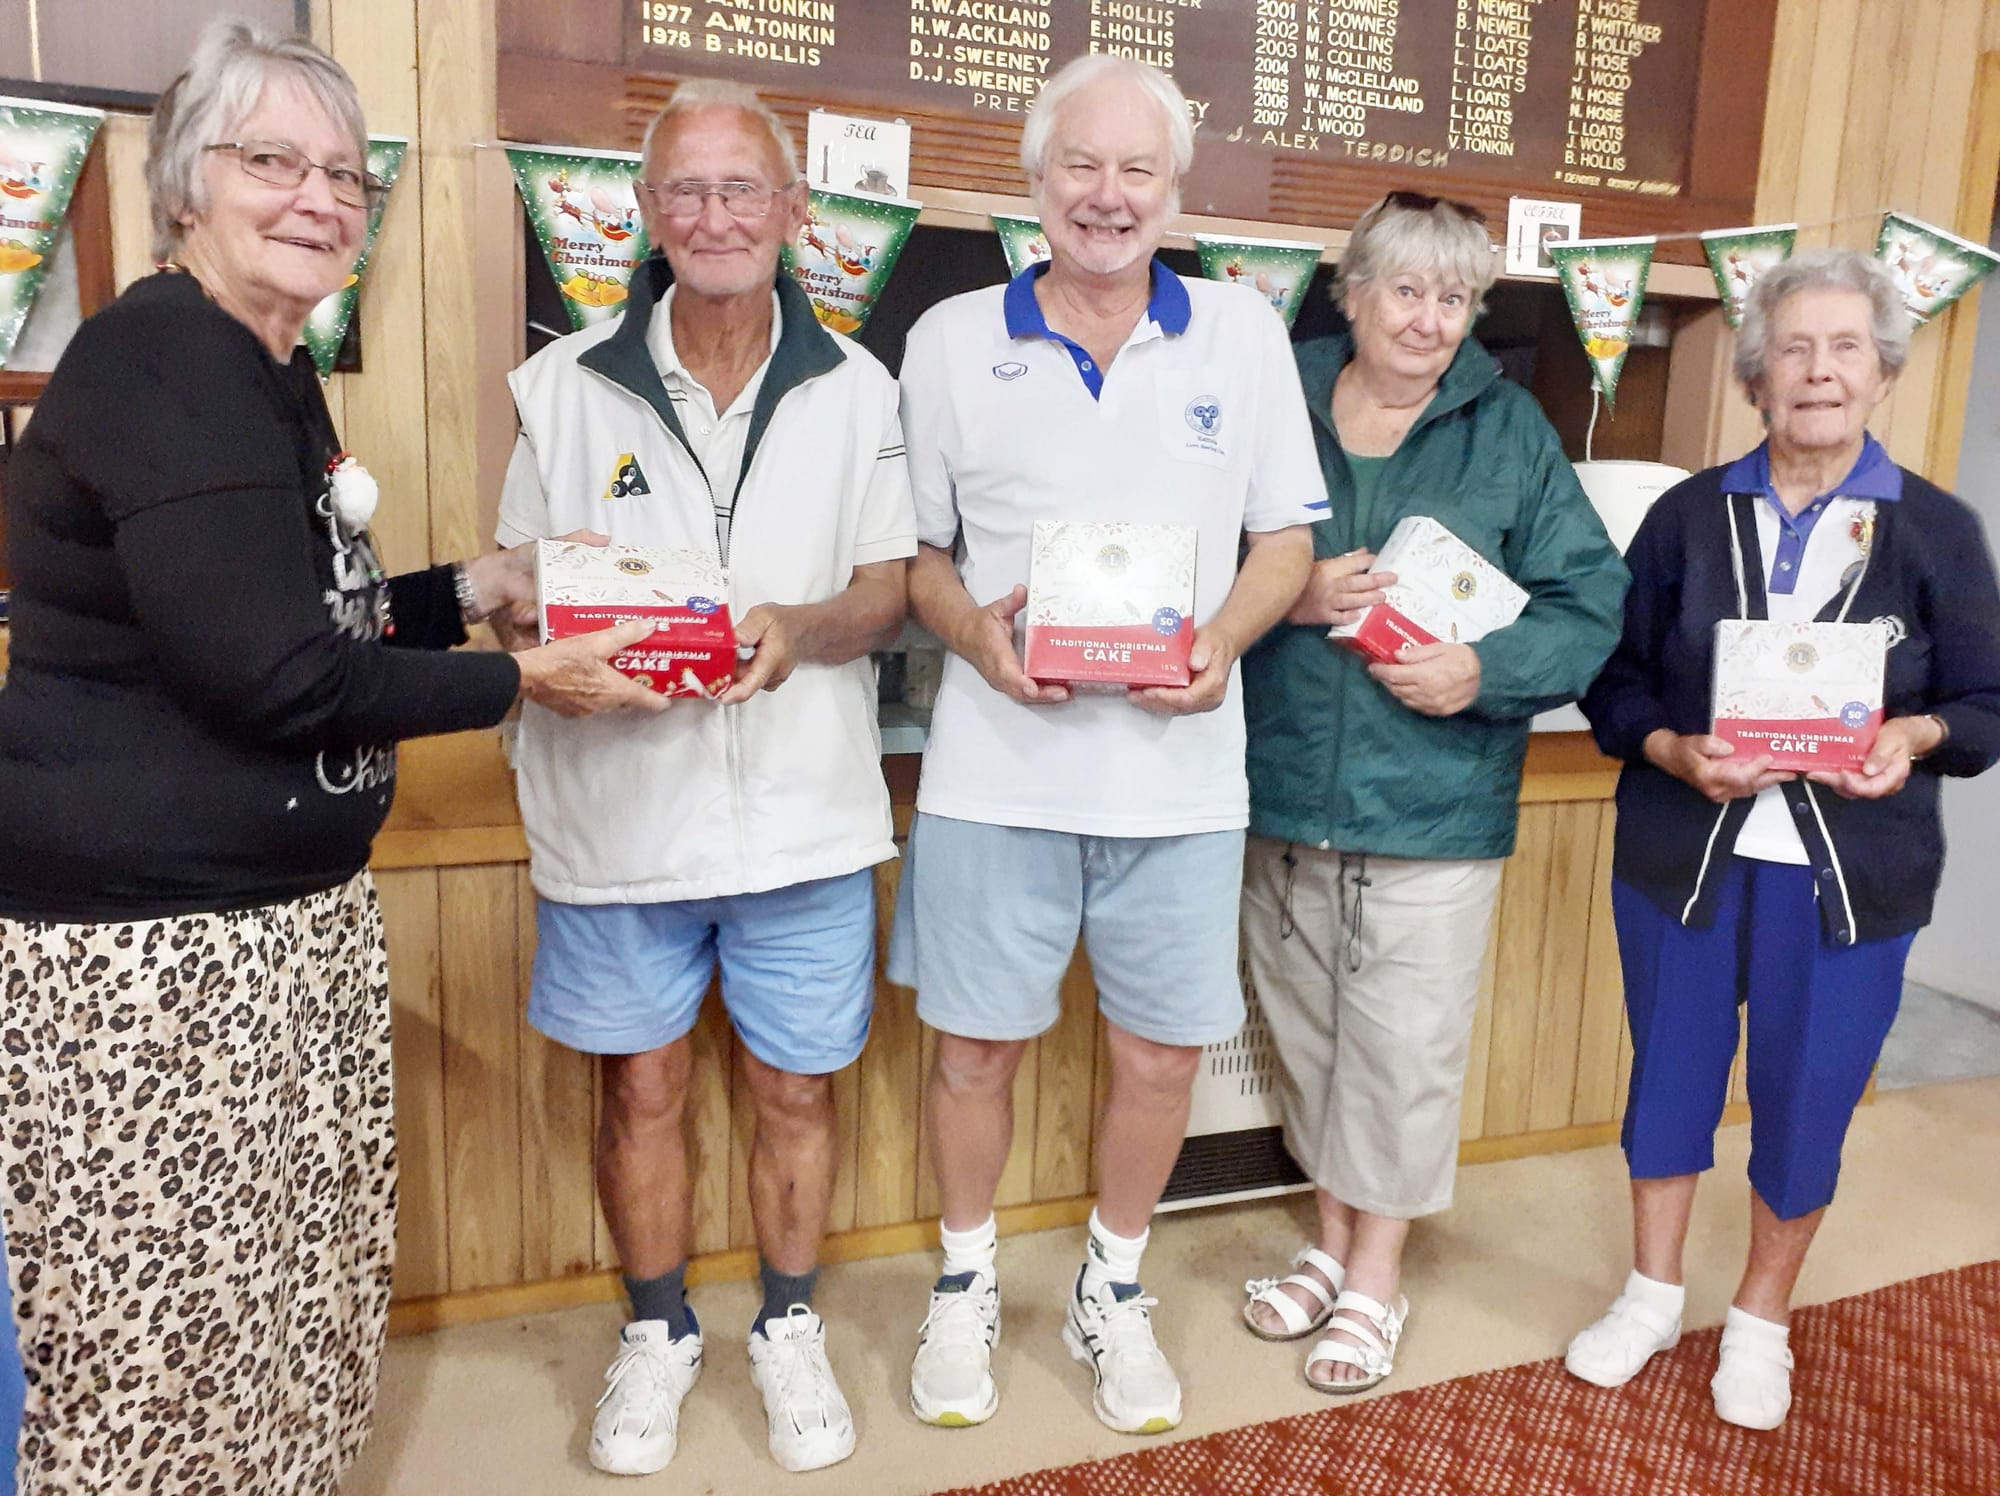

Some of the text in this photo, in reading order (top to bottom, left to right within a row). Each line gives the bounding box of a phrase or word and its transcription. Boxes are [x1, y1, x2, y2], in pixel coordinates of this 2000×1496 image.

[1090, 0, 1174, 27] E.HOLLIS
[1256, 0, 1397, 37] 2001 K. DOWNES
[1597, 0, 1639, 22] HOSE
[643, 1, 834, 46] 1977 A.W.TONKIN
[911, 16, 1051, 51] H.W.ACKLAND
[1090, 19, 1174, 48] E.HOLLIS
[1455, 13, 1532, 41] B. NEWELL
[1591, 17, 1663, 44] WHITTAKER
[643, 26, 692, 48] 1978
[1256, 18, 1394, 55] 2002 M. COLLINS
[1454, 31, 1529, 58] L. LOATS
[1591, 35, 1644, 57] HOLLIS
[910, 39, 1050, 74] D.J.SWEENEY
[1255, 38, 1393, 73] 2003 M. COLLINS
[1453, 49, 1528, 76] L. LOATS
[1574, 50, 1629, 73] N. HOSE
[909, 61, 1050, 95] D.J.SWEENEY
[1254, 57, 1419, 95] 2004 W. McCLELLAND
[1452, 68, 1527, 94] L. LOATS
[1571, 67, 1632, 91] J. WOOD
[1253, 76, 1424, 114] 2005 W. McCLELLAND
[1465, 88, 1511, 108] LOATS
[1570, 85, 1625, 107] N. HOSE
[1253, 92, 1366, 121] 2006 J. WOOD
[1465, 106, 1513, 126] LOATS
[1586, 106, 1625, 124] HOSE
[843, 123, 876, 141] TEA
[1253, 109, 1365, 138] 2007 J. WOOD
[1463, 122, 1510, 141] LOATS
[1582, 122, 1625, 142] LOATS
[1261, 130, 1320, 151] ALEX
[1447, 135, 1515, 157] V. TONKIN
[1580, 137, 1622, 155] WOOD
[1580, 152, 1627, 172] HOLLIS
[551, 236, 605, 254] Merry
[795, 266, 844, 286] Merry
[573, 613, 708, 624] TRADITIONAL CHRISTMAS
[649, 650, 711, 661] CHRISTMAS
[1050, 639, 1167, 652] TRADITIONAL CHRISTMAS
[1084, 649, 1132, 663] CAKE
[614, 658, 671, 671] CAKE
[1737, 731, 1854, 744] TRADITIONAL CHRISTMAS
[1769, 740, 1819, 754] CAKE
